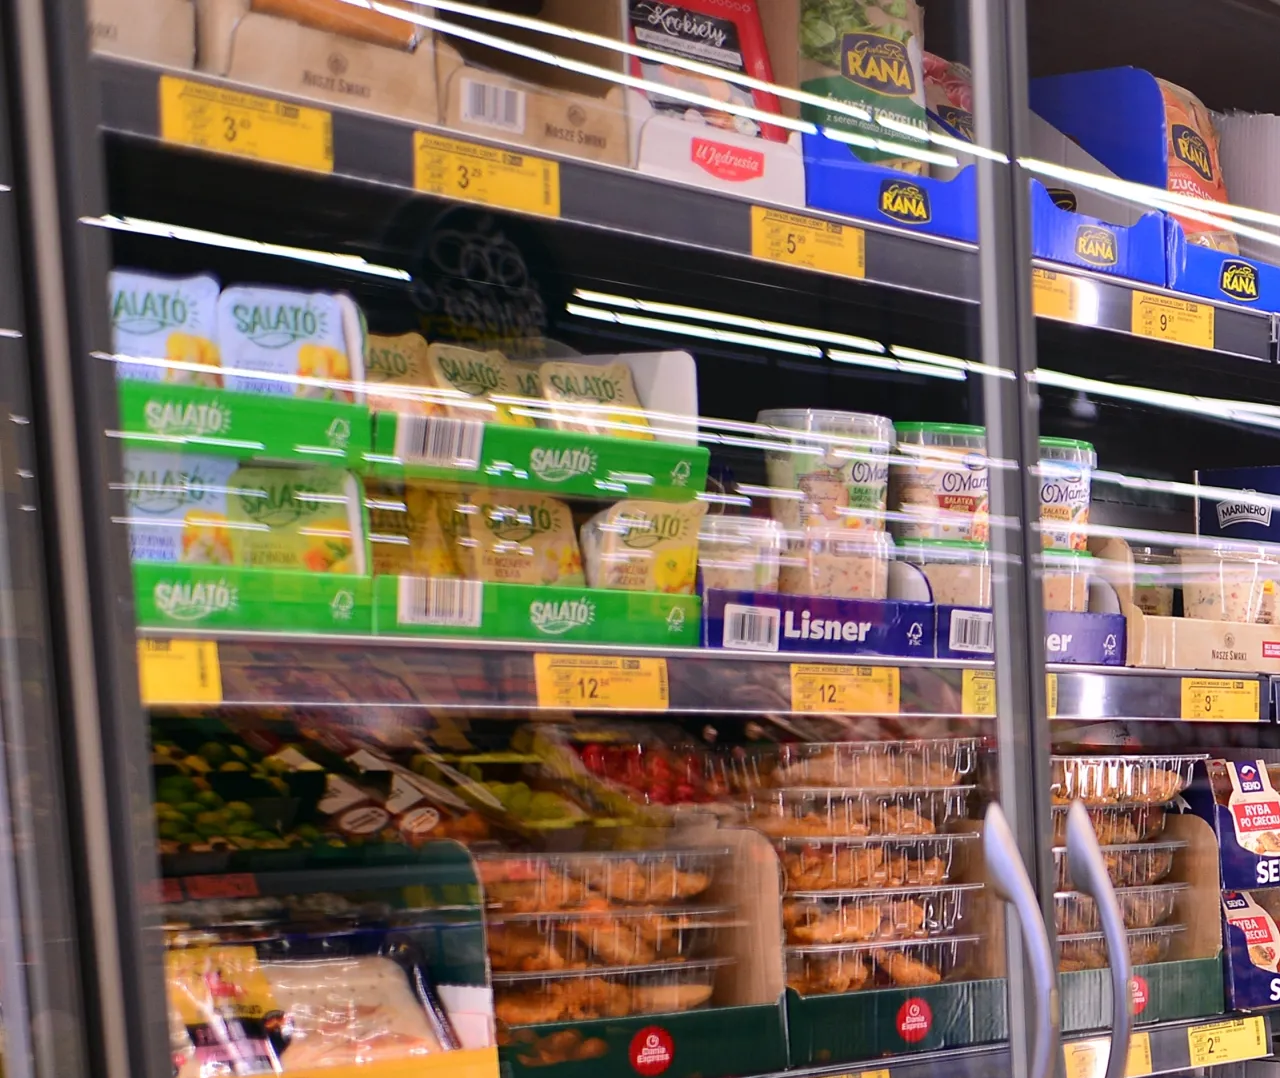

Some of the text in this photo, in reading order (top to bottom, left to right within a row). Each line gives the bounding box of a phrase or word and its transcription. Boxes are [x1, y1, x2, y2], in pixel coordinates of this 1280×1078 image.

[846, 51, 912, 90] RANA
[1178, 138, 1211, 177] RANA
[882, 192, 927, 218] RANA
[787, 234, 796, 254] 5
[1078, 236, 1114, 261] RANA
[1223, 272, 1257, 296] RANA
[1160, 314, 1167, 331] 9
[1221, 504, 1266, 519] MARINERO
[784, 610, 872, 643] Lisner
[1211, 650, 1247, 661] NASZE SMAKI
[577, 678, 599, 699] 12
[818, 684, 837, 703] 12
[1243, 781, 1261, 791] SEKO
[1245, 803, 1270, 815] RYBA
[1240, 814, 1280, 827] PO GRECKU
[1227, 899, 1246, 908] SEKO
[1246, 928, 1268, 940] RECKU
[1207, 1038, 1214, 1054] 2
